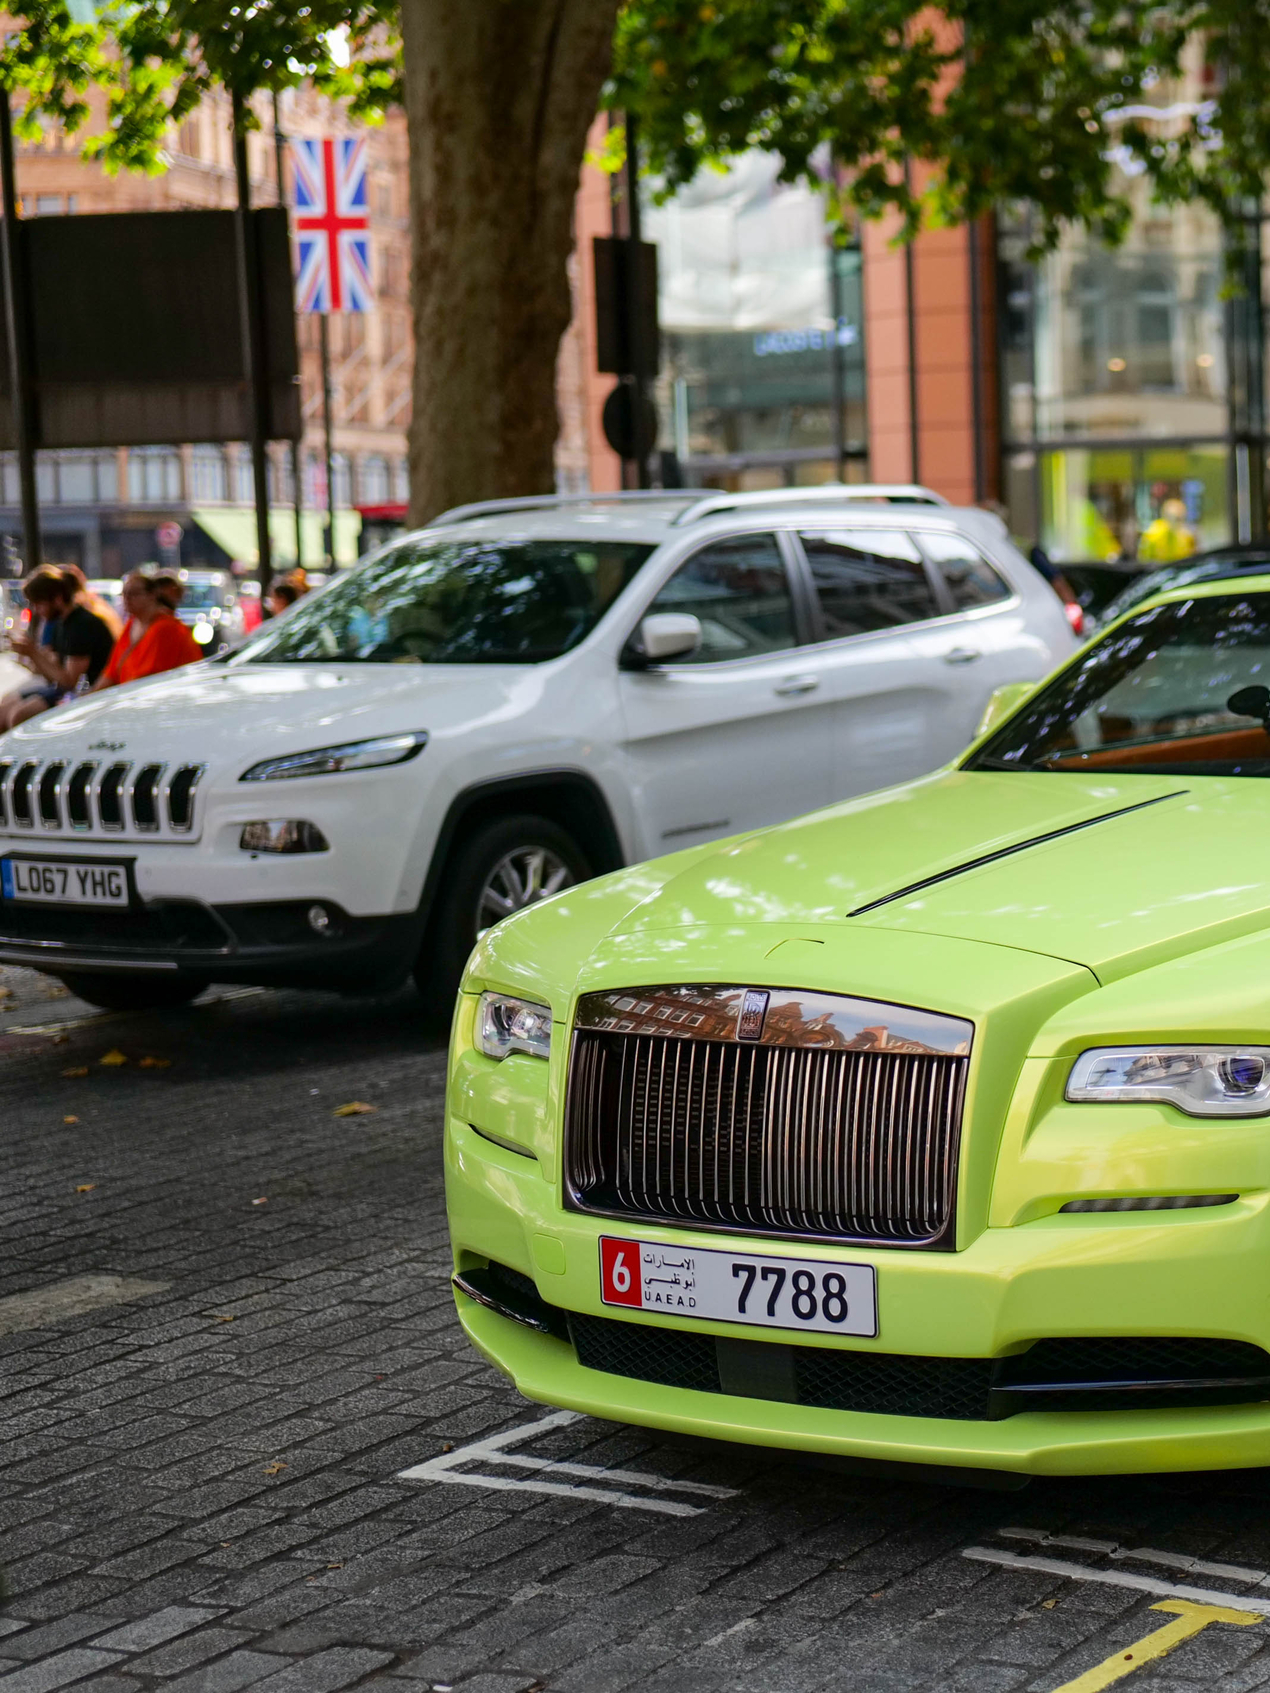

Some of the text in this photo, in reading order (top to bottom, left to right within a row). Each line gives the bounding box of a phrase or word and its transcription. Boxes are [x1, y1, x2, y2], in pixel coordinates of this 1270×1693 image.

[15, 864, 122, 897] LO67 YHG
[612, 1251, 631, 1293] 6
[731, 1263, 849, 1323] 7788
